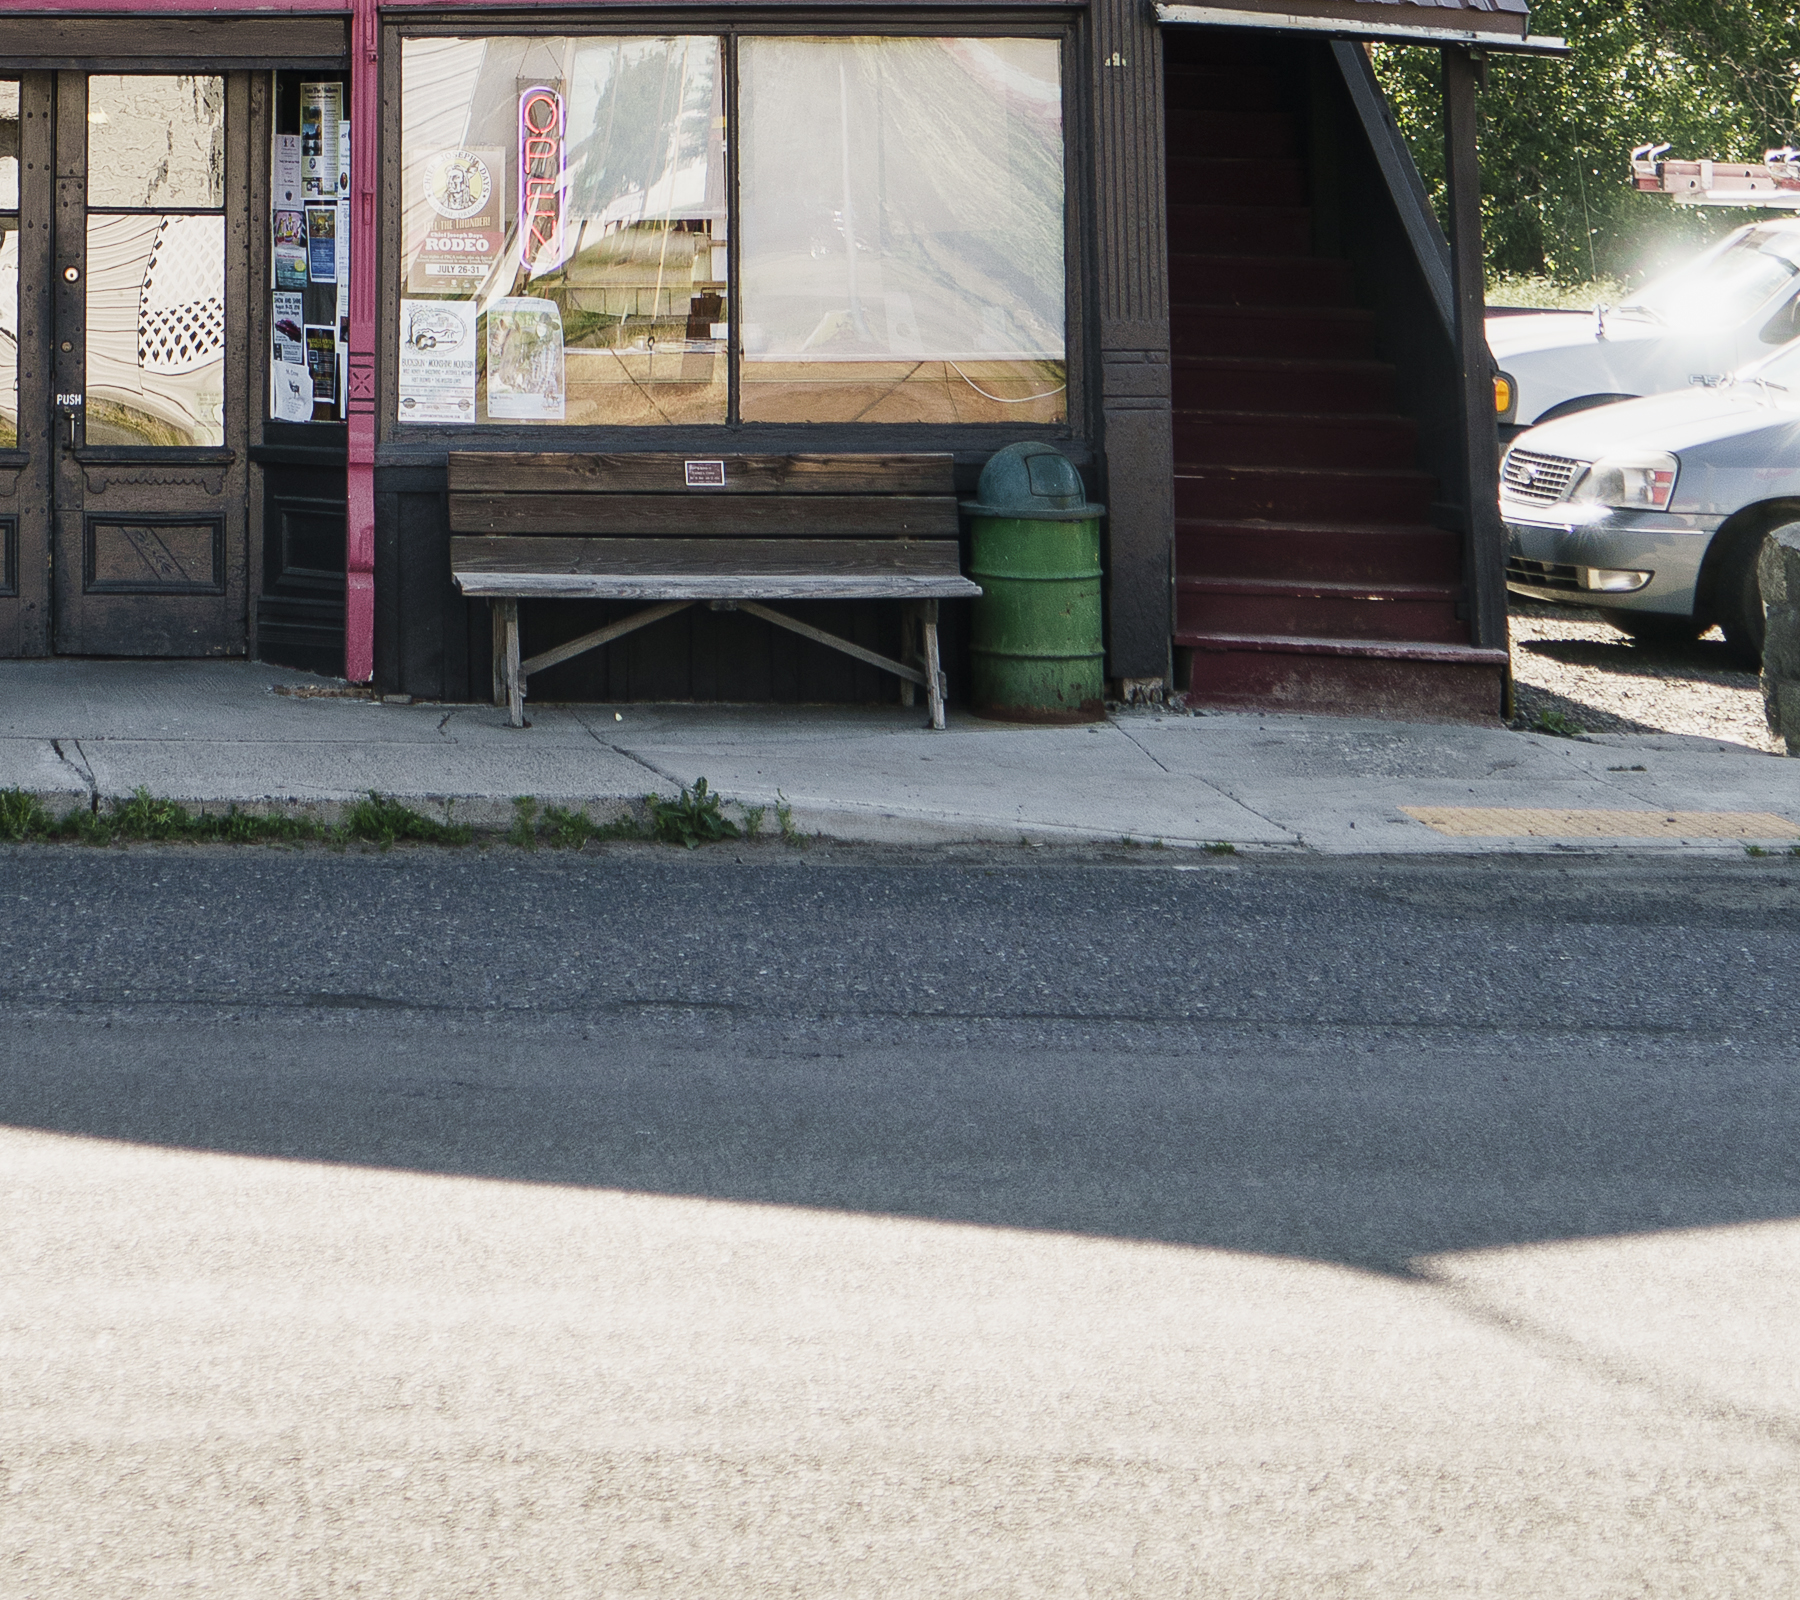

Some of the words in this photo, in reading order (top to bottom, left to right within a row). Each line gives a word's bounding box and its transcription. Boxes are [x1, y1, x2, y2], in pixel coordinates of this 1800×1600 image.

[479, 167, 490, 194] DAYS
[524, 94, 558, 259] OPEN
[455, 216, 491, 229] THUNDER!
[425, 238, 490, 252] RODEO
[436, 265, 456, 274] JULY
[457, 265, 480, 274] 26-31
[56, 393, 82, 406] PUSH
